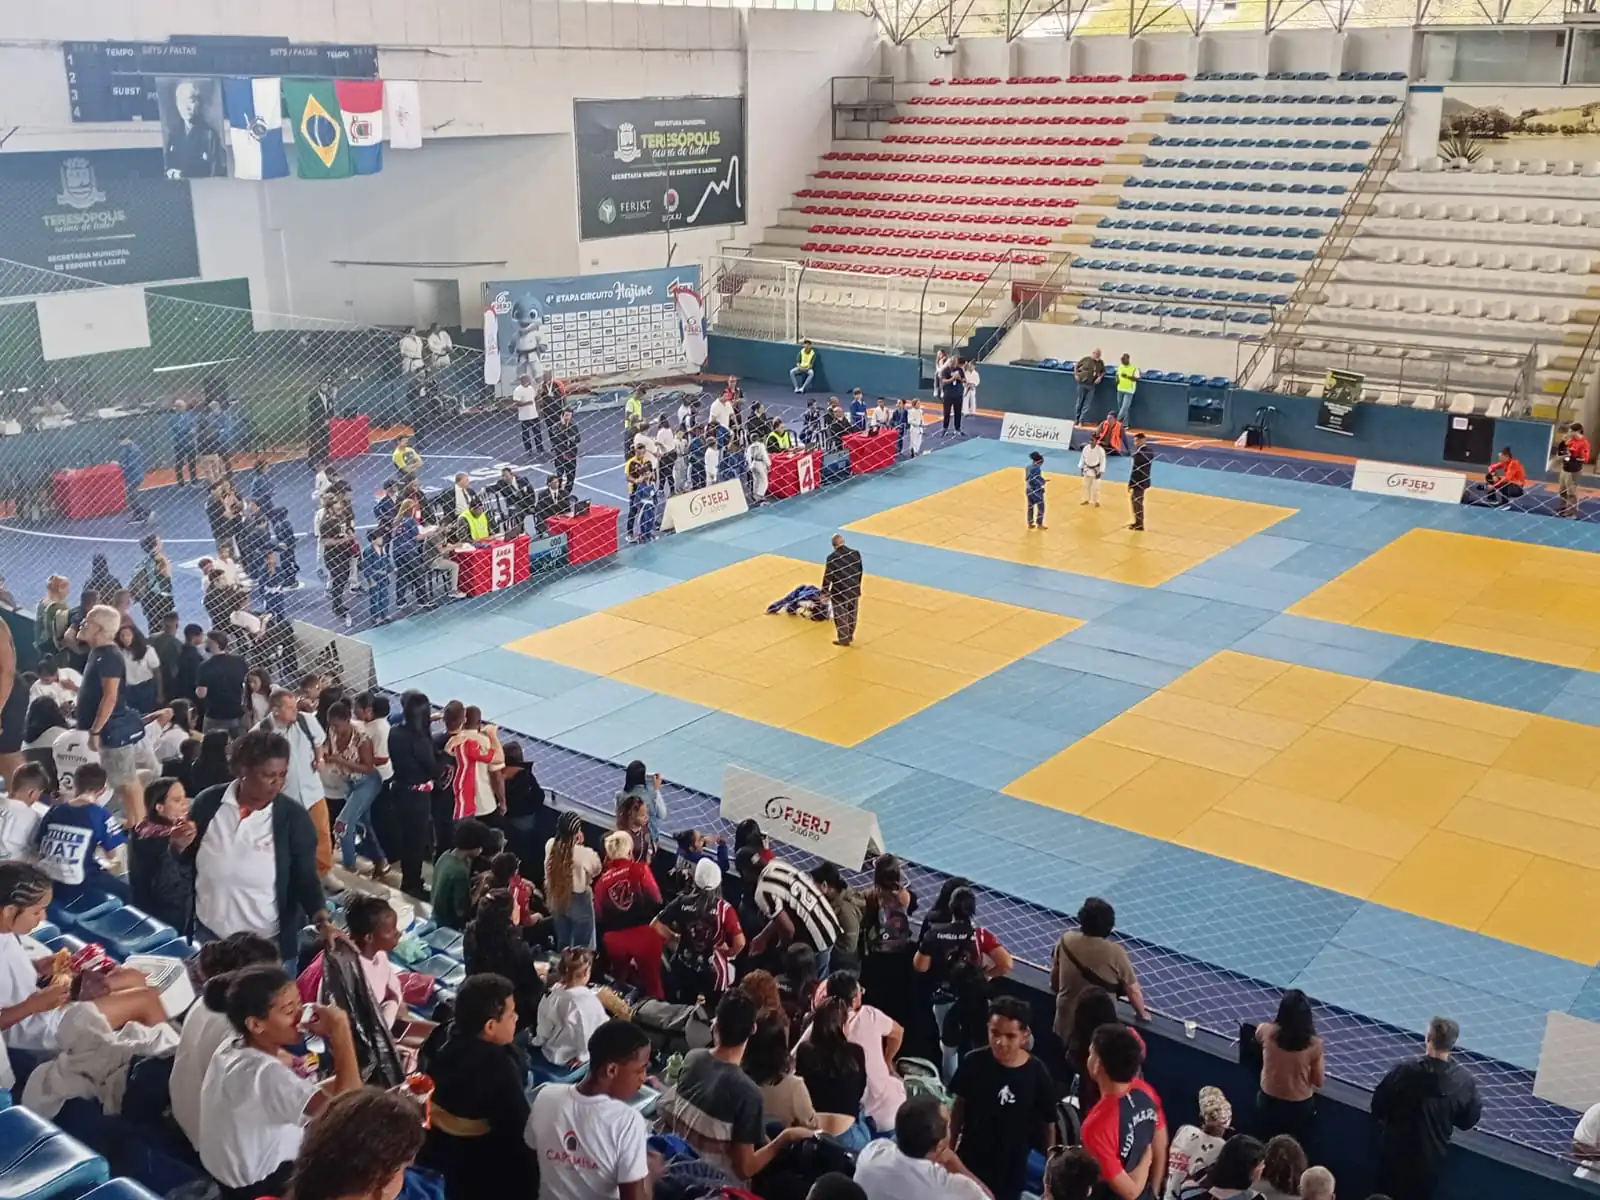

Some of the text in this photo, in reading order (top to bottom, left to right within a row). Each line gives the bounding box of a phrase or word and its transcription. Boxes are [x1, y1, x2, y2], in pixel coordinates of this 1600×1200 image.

[105, 48, 134, 57] TEMPO
[327, 51, 350, 59] TEMPO
[67, 54, 73, 66] 1
[68, 72, 77, 84] 2
[71, 89, 79, 101] 3
[112, 86, 141, 96] SUBST
[73, 106, 81, 118] 4
[640, 129, 721, 149] TERESÓPOLIS
[42, 209, 126, 227] TERESÓPOLIS
[556, 293, 580, 304] ETAPA
[580, 290, 614, 301] CIRCUITO
[613, 280, 655, 305] Hajime
[1018, 426, 1060, 441] SEISHIN
[802, 466, 813, 490] 4
[1402, 478, 1436, 491] FJERJ
[701, 489, 730, 508] FJERJ
[496, 557, 512, 590] 3
[784, 806, 832, 836] FJERJ
